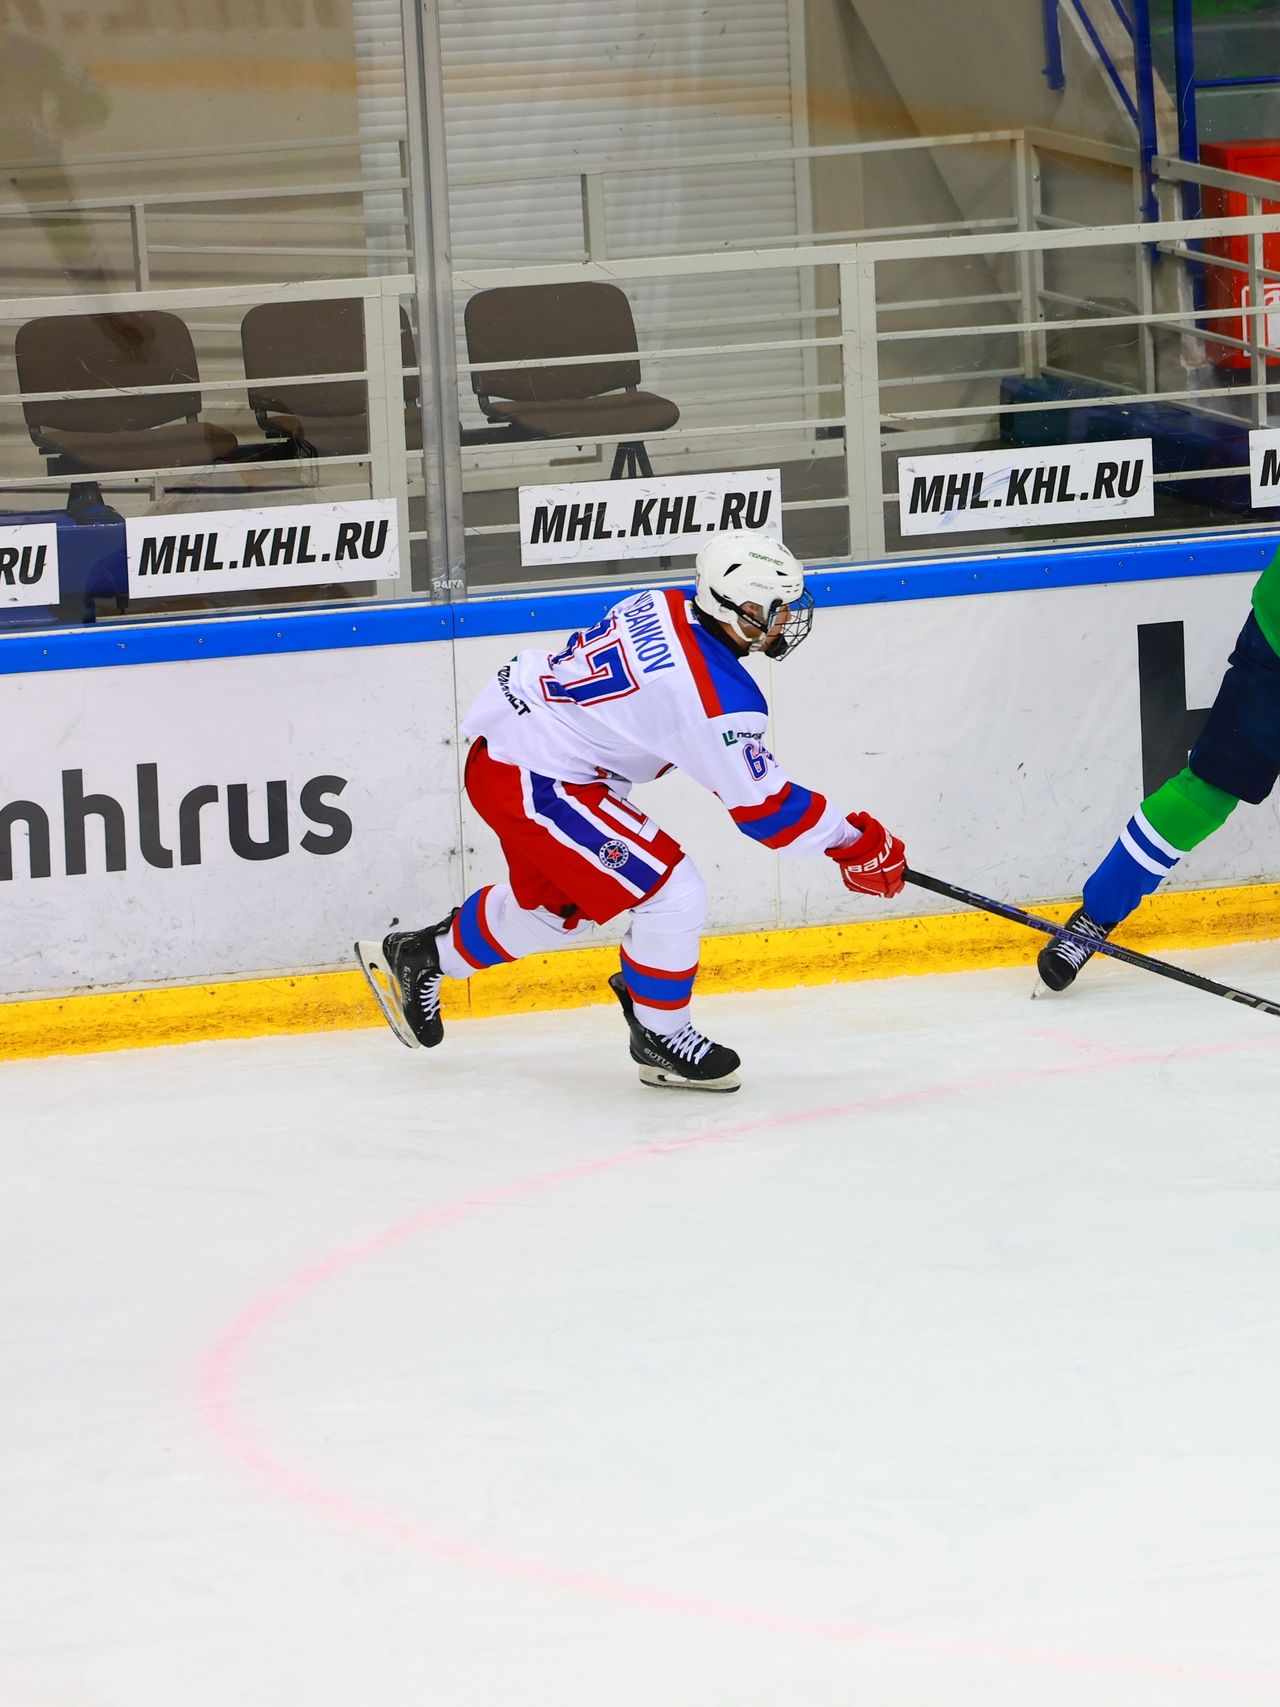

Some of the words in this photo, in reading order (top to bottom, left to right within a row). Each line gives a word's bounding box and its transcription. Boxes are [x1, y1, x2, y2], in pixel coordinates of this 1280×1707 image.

[909, 460, 1144, 514] MHL.KHL.RU
[530, 490, 772, 544] MHL.KHL.RU
[138, 520, 389, 576] MHL.KHL.RU
